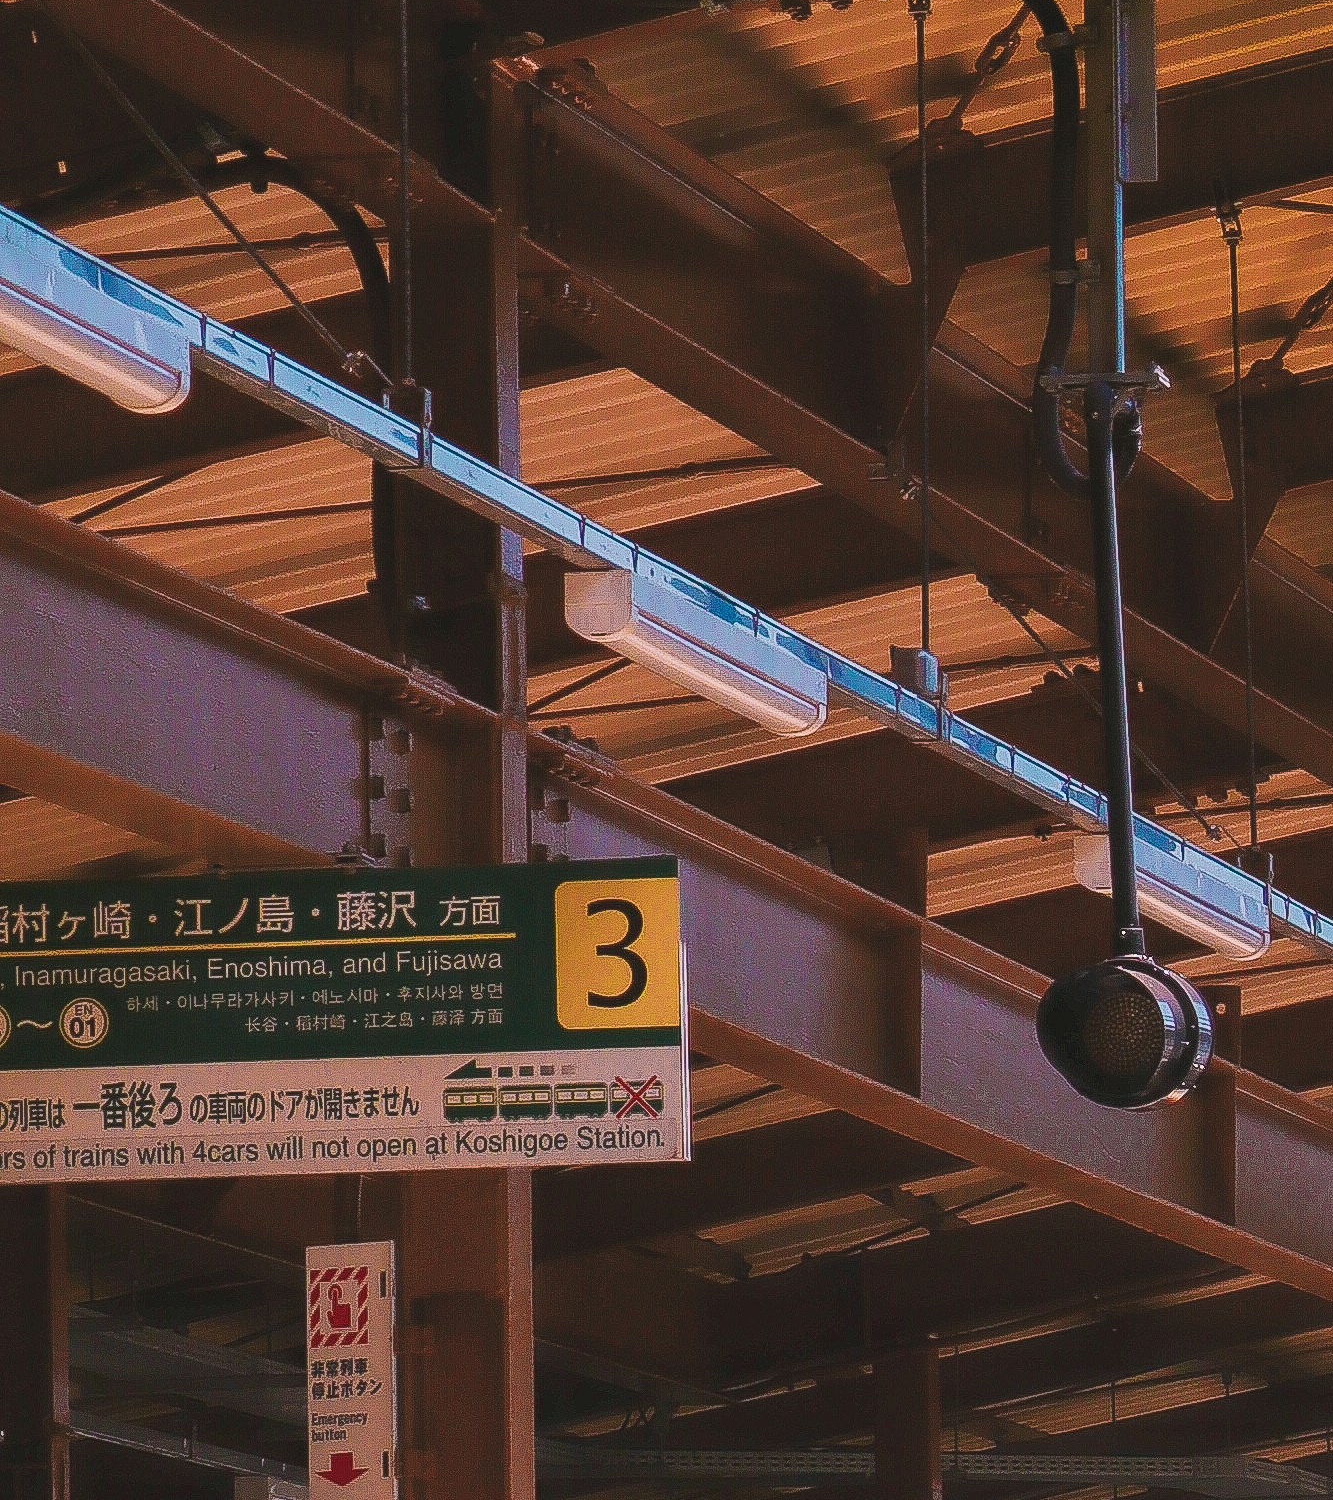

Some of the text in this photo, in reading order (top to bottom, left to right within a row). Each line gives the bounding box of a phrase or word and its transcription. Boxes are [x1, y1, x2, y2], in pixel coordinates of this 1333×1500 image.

[439, 895, 501, 928] 方面
[585, 897, 648, 1009] 3
[15, 949, 503, 989] Inamuragasaki, Enoshima, and Fujisawa
[74, 1003, 93, 1016] EN
[470, 1008, 503, 1026] 方面
[69, 1016, 96, 1039] 01
[0, 1125, 665, 1170] rs of trains with 4cars will not open at Koshigoe Station.
[311, 1357, 369, 1378] 非常列車
[311, 1379, 382, 1400] 停止ボタン
[311, 1412, 368, 1428] Emergency
[311, 1429, 347, 1443] button
